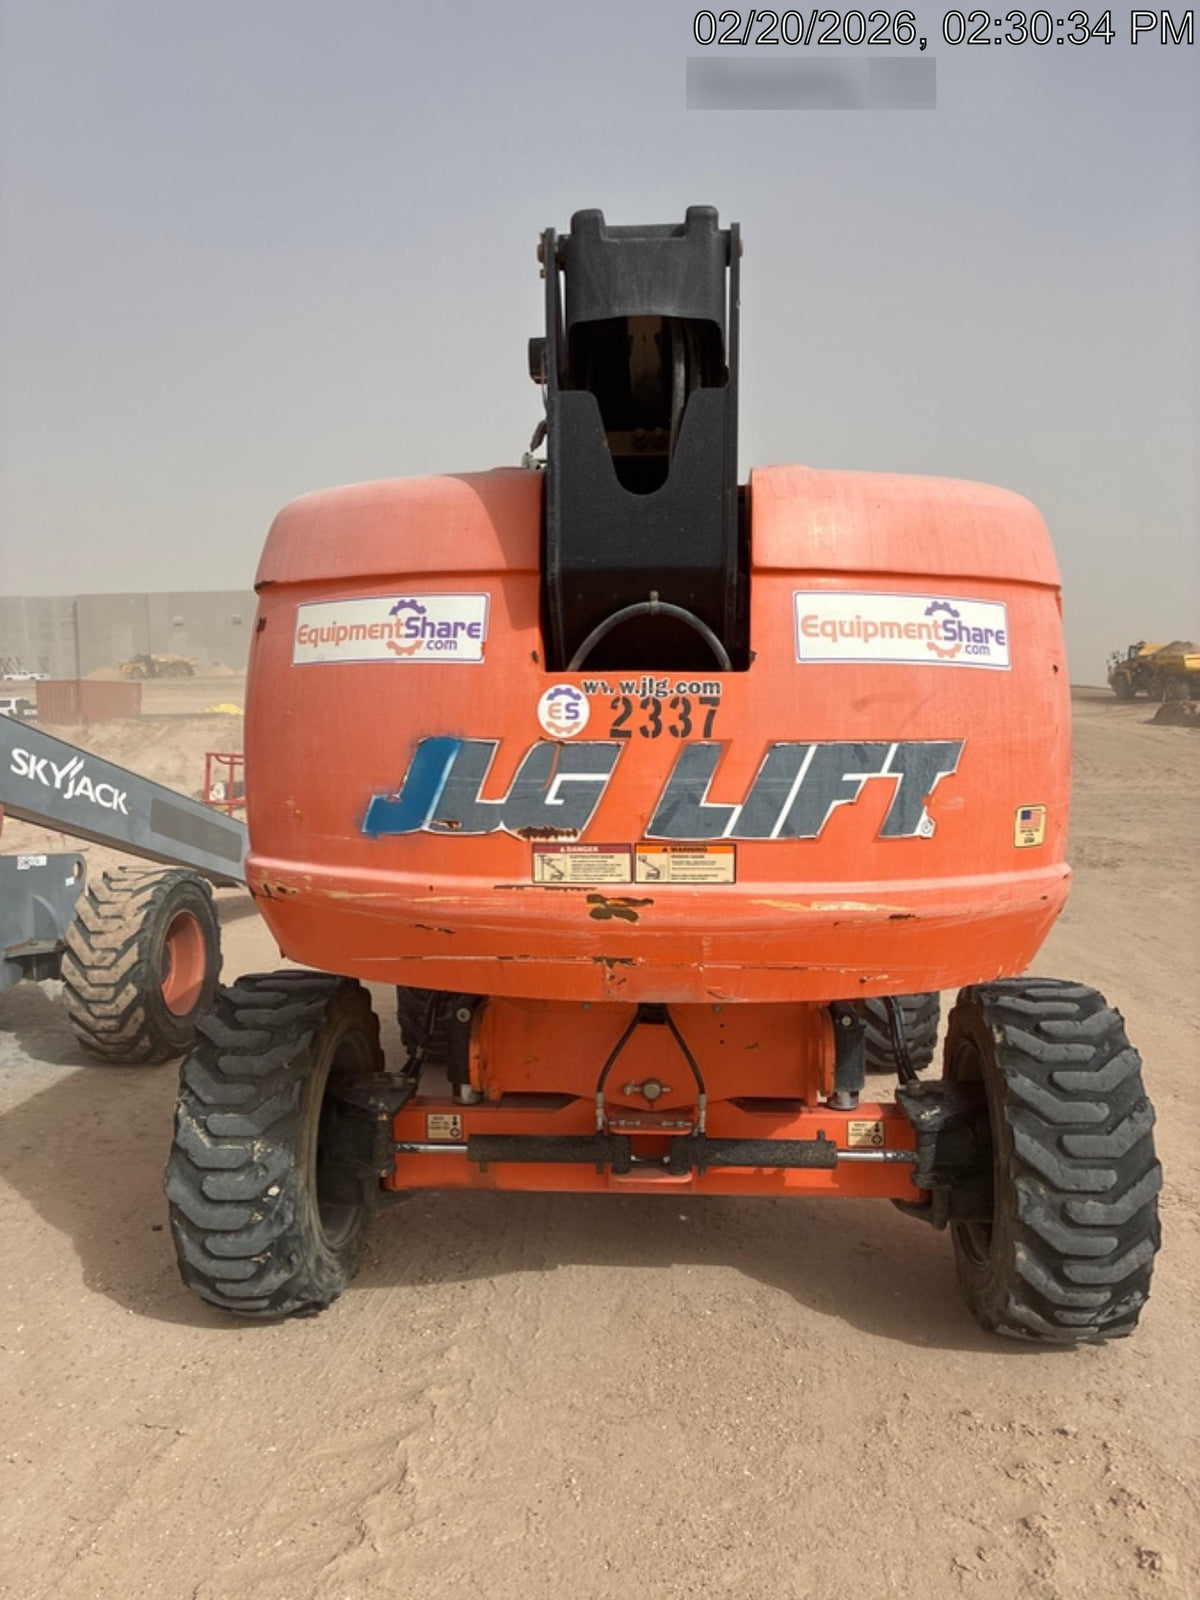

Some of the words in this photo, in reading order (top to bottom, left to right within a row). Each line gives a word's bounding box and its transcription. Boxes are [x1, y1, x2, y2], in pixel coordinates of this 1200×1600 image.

[297, 616, 482, 648] EquipmentShare
[800, 614, 1006, 646] EquipmentShare
[547, 701, 580, 721] ES
[609, 696, 721, 739] 2337
[10, 747, 129, 815] SKYJACK
[362, 737, 625, 839] JLG
[644, 738, 965, 841] LIFT
